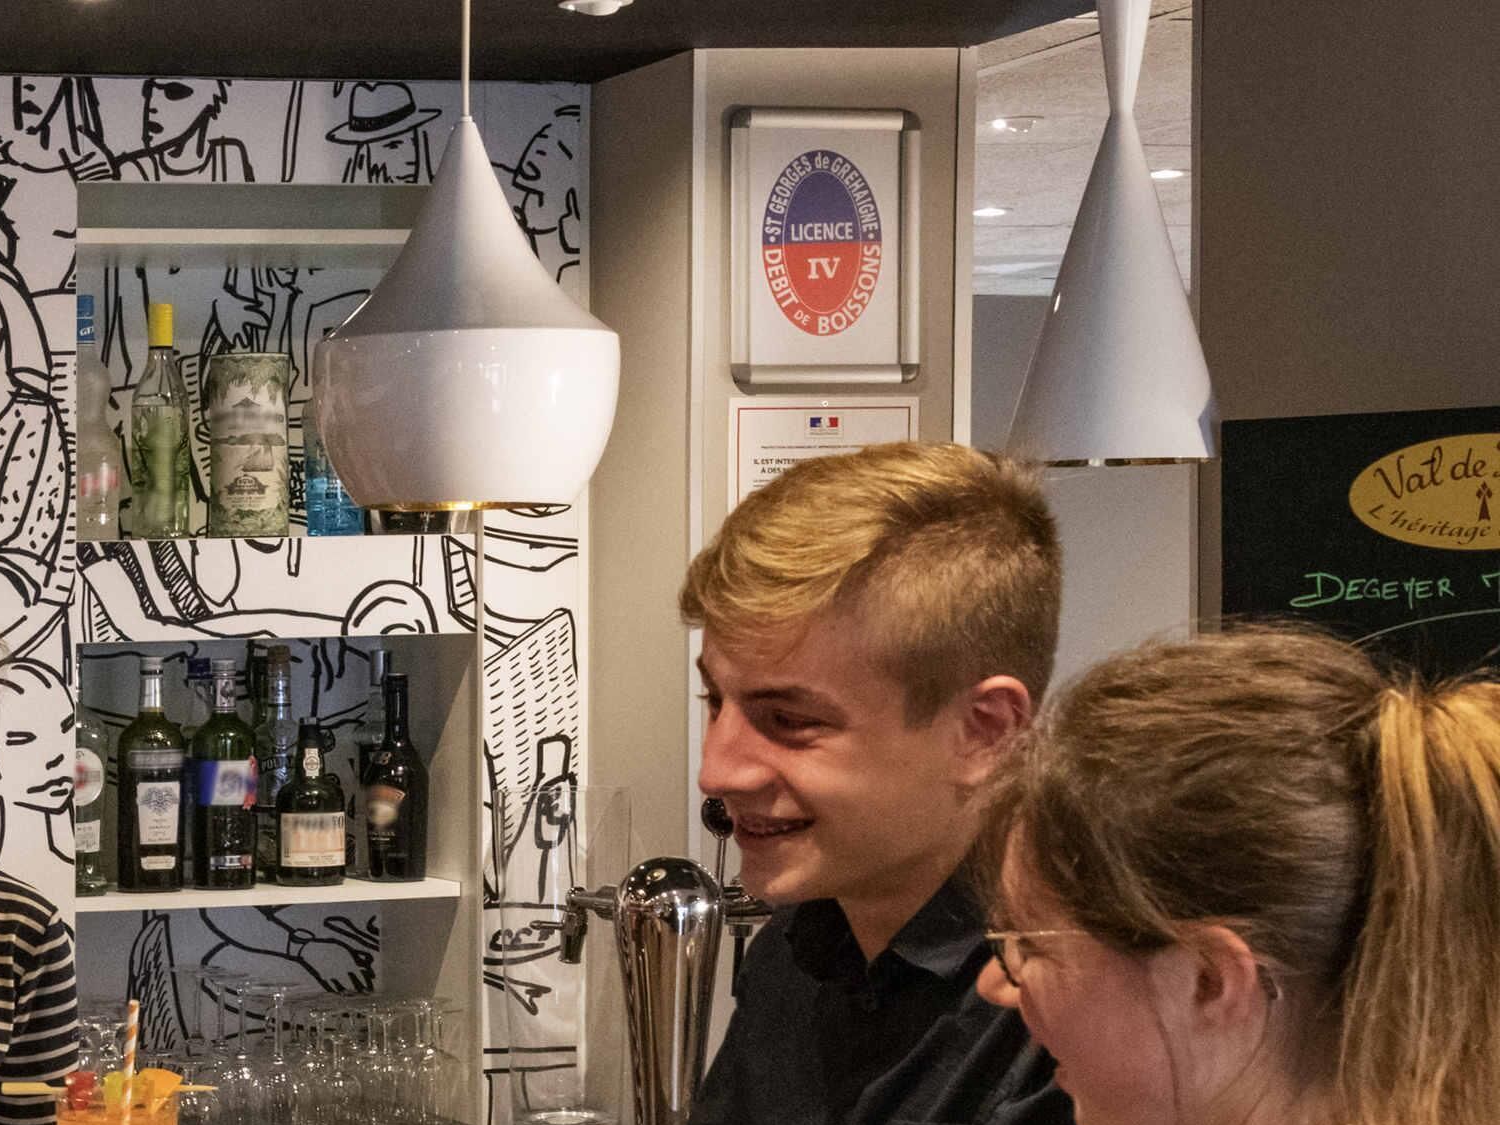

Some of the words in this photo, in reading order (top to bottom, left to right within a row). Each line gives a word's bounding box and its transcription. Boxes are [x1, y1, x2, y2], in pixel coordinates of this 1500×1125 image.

[814, 151, 830, 169] de
[768, 155, 813, 215] GEORGES
[830, 156, 879, 233] GREHAIGNE
[764, 217, 782, 236] ST
[790, 221, 854, 241] LICENCE
[807, 257, 841, 280] IV
[764, 248, 800, 309] DEBIT
[793, 309, 812, 327] DE
[817, 244, 881, 335] BOISSONS
[1373, 445, 1445, 499] Val
[1450, 447, 1487, 480] de
